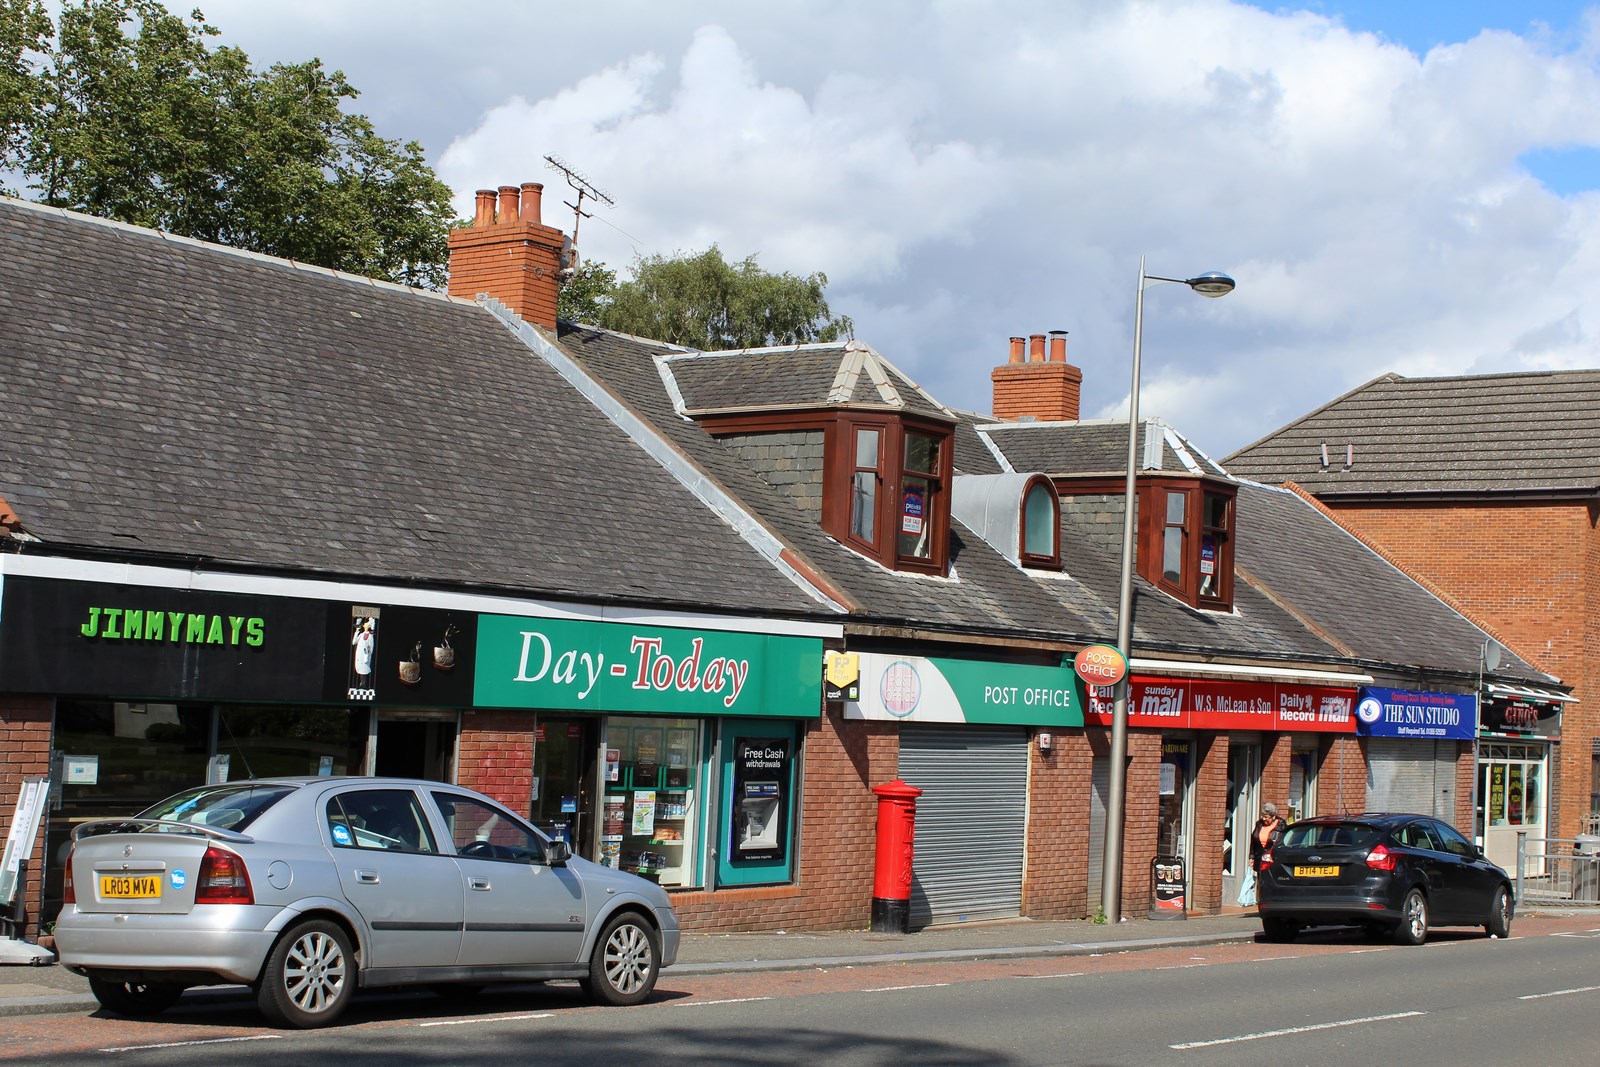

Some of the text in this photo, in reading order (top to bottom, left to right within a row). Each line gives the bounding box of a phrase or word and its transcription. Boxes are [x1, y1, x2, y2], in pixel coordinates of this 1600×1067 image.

[81, 607, 265, 647] JIMMYMAYS
[1086, 651, 1115, 665] POST
[1080, 663, 1116, 678] OFFICE
[888, 674, 914, 688] POST
[885, 689, 915, 704] OFFICE
[985, 686, 1070, 707] POST OFFICE
[1145, 686, 1177, 696] sunday
[1140, 689, 1184, 717] mail
[1216, 696, 1247, 713] McLean
[1250, 699, 1255, 714] &
[1257, 698, 1272, 715] Son
[1280, 693, 1305, 709] Daily
[1321, 696, 1346, 705] sunday
[1280, 708, 1315, 722] Record
[1318, 698, 1351, 723] mail
[1384, 704, 1460, 726] THE SUN STUDIO
[744, 748, 784, 759] Free Cash
[746, 760, 781, 768] withdrawals
[1495, 774, 1502, 785] 3
[333, 829, 349, 839] Yes
[1299, 866, 1334, 875] BT14 TEJ
[171, 873, 185, 884] Yes
[104, 879, 156, 895] LR03 MVA
